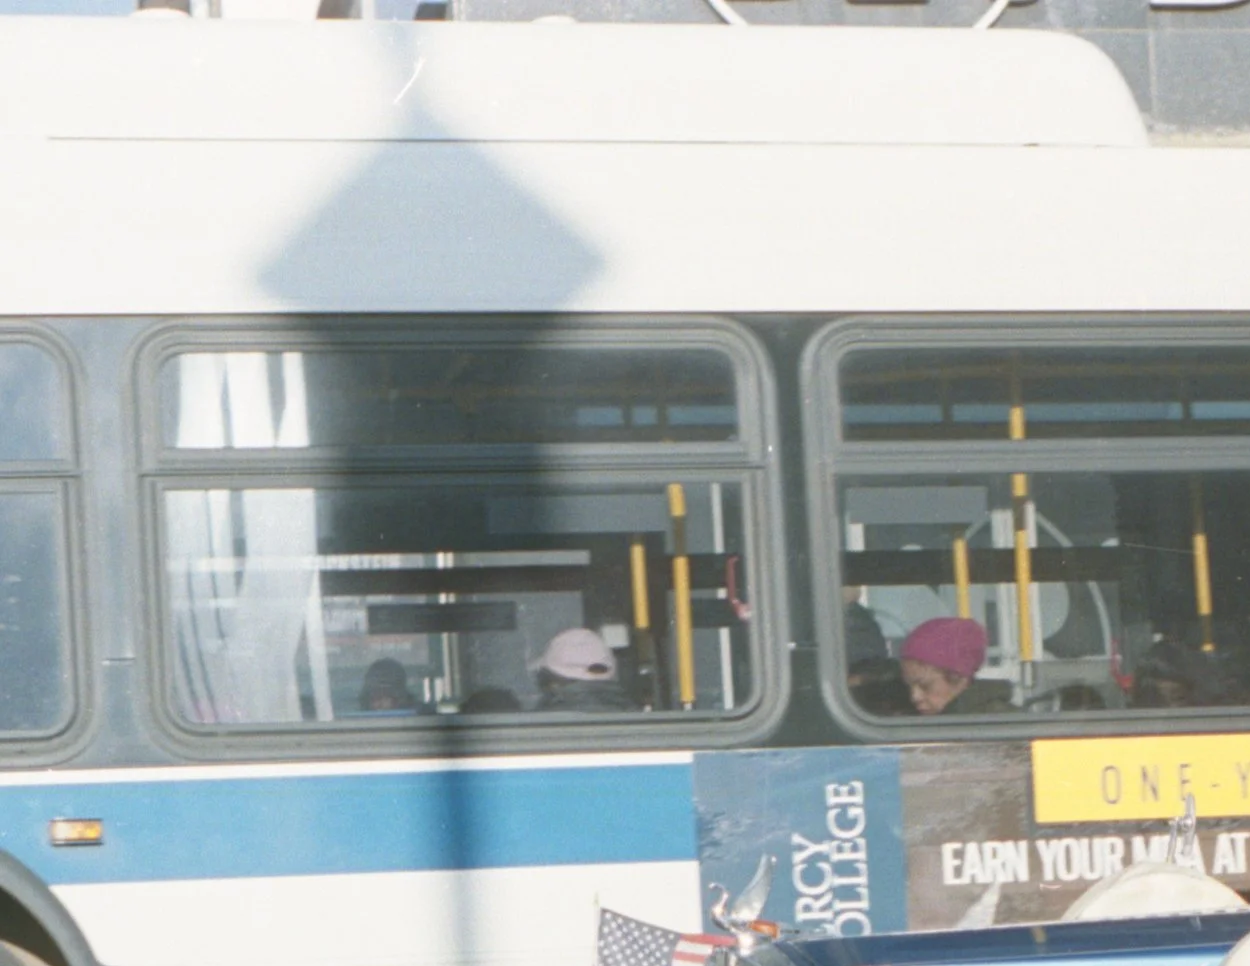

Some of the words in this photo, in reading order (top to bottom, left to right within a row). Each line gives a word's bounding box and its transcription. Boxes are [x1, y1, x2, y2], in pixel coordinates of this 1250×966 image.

[791, 833, 833, 936] RCY
[825, 780, 872, 937] OLLEGE
[941, 840, 1030, 885] EARN
[1036, 836, 1125, 882] YOUR
